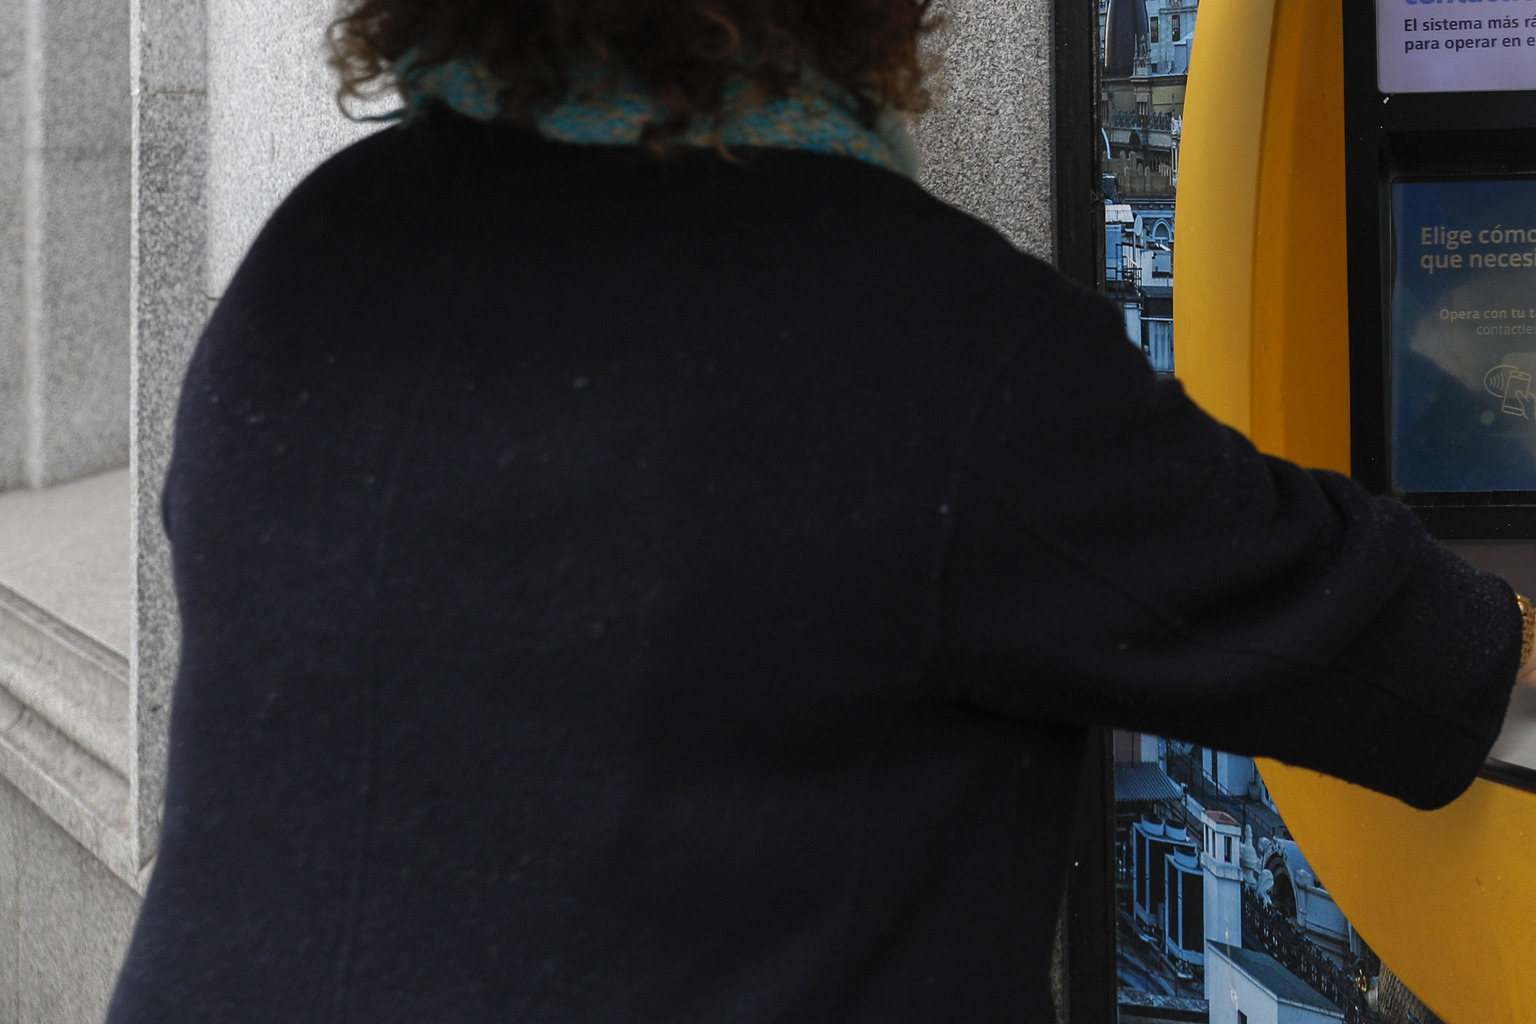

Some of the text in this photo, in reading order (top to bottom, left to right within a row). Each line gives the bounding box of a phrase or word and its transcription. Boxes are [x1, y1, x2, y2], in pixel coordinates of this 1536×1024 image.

[1404, 18, 1418, 32] El
[1422, 17, 1482, 32] sistema
[1488, 15, 1519, 30] más
[1404, 38, 1440, 54] para
[1444, 36, 1498, 52] operar
[1502, 35, 1521, 48] en
[1420, 225, 1473, 250] Elige
[1420, 253, 1463, 275] que
[1439, 308, 1480, 323] Opera
[1483, 308, 1507, 319] con
[1511, 308, 1525, 319] tu
